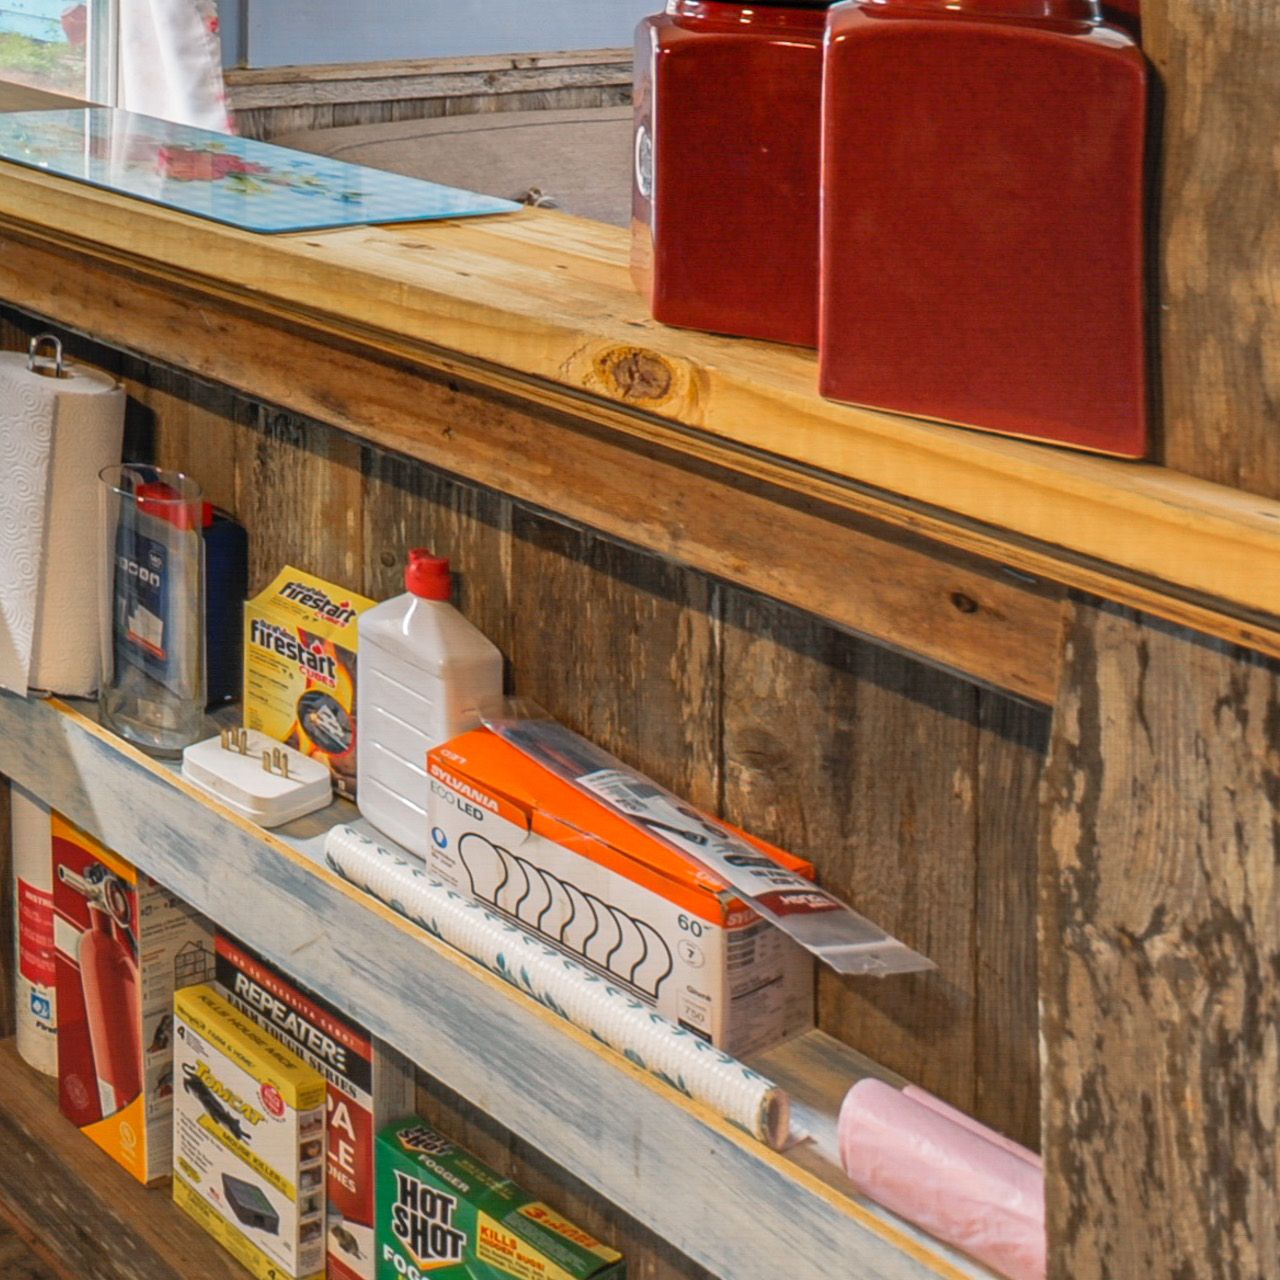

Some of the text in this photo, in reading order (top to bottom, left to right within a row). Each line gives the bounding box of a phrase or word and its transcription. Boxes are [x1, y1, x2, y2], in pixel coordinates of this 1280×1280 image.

[278, 581, 356, 623] firestart
[250, 619, 337, 680] firestart
[298, 663, 336, 689] CUBES
[430, 764, 500, 813] SYLVANIA
[430, 780, 484, 822] ECO LED
[177, 1025, 186, 1040] 4
[234, 971, 344, 1067] REPEATER
[228, 1017, 266, 1048] HOUSE
[265, 1045, 298, 1070] MICE
[195, 1058, 265, 1126] TOMCAT
[309, 1056, 358, 1099] SERIES
[417, 1153, 470, 1193] FOGGER
[395, 1169, 457, 1227] HOT
[392, 1202, 467, 1261] SHOT
[480, 1225, 517, 1251] KILLS
